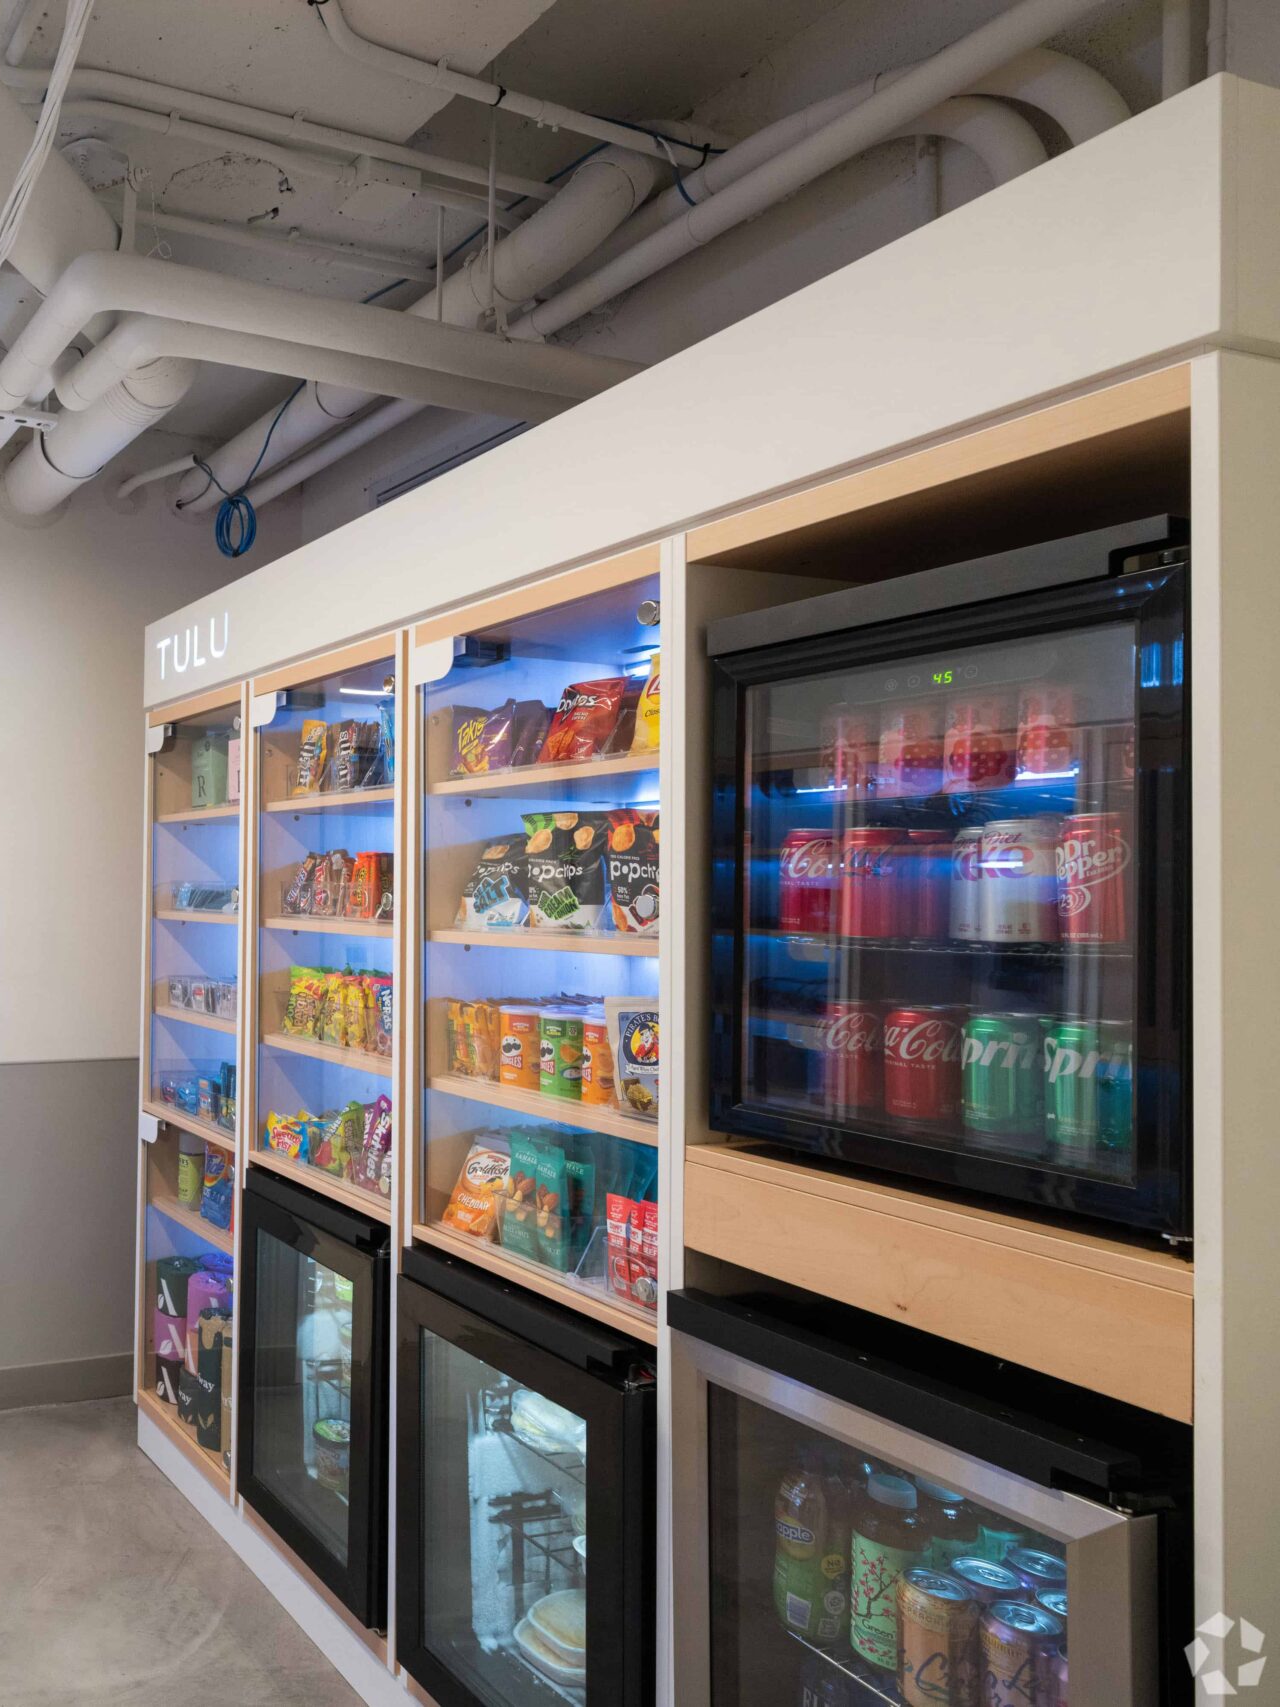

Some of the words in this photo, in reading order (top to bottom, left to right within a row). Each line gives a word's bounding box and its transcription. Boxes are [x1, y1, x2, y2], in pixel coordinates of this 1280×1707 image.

[156, 611, 229, 681] TULU
[932, 670, 954, 685] 45
[1064, 838, 1097, 860] Dr
[1060, 894, 1073, 909] 23
[625, 1012, 652, 1038] PIRATE'S
[961, 1027, 1039, 1071] pri
[1043, 1036, 1133, 1084] Spri
[467, 1161, 510, 1177] Goldfish
[457, 1192, 490, 1211] CHEDDAR
[861, 1618, 894, 1639] Green
